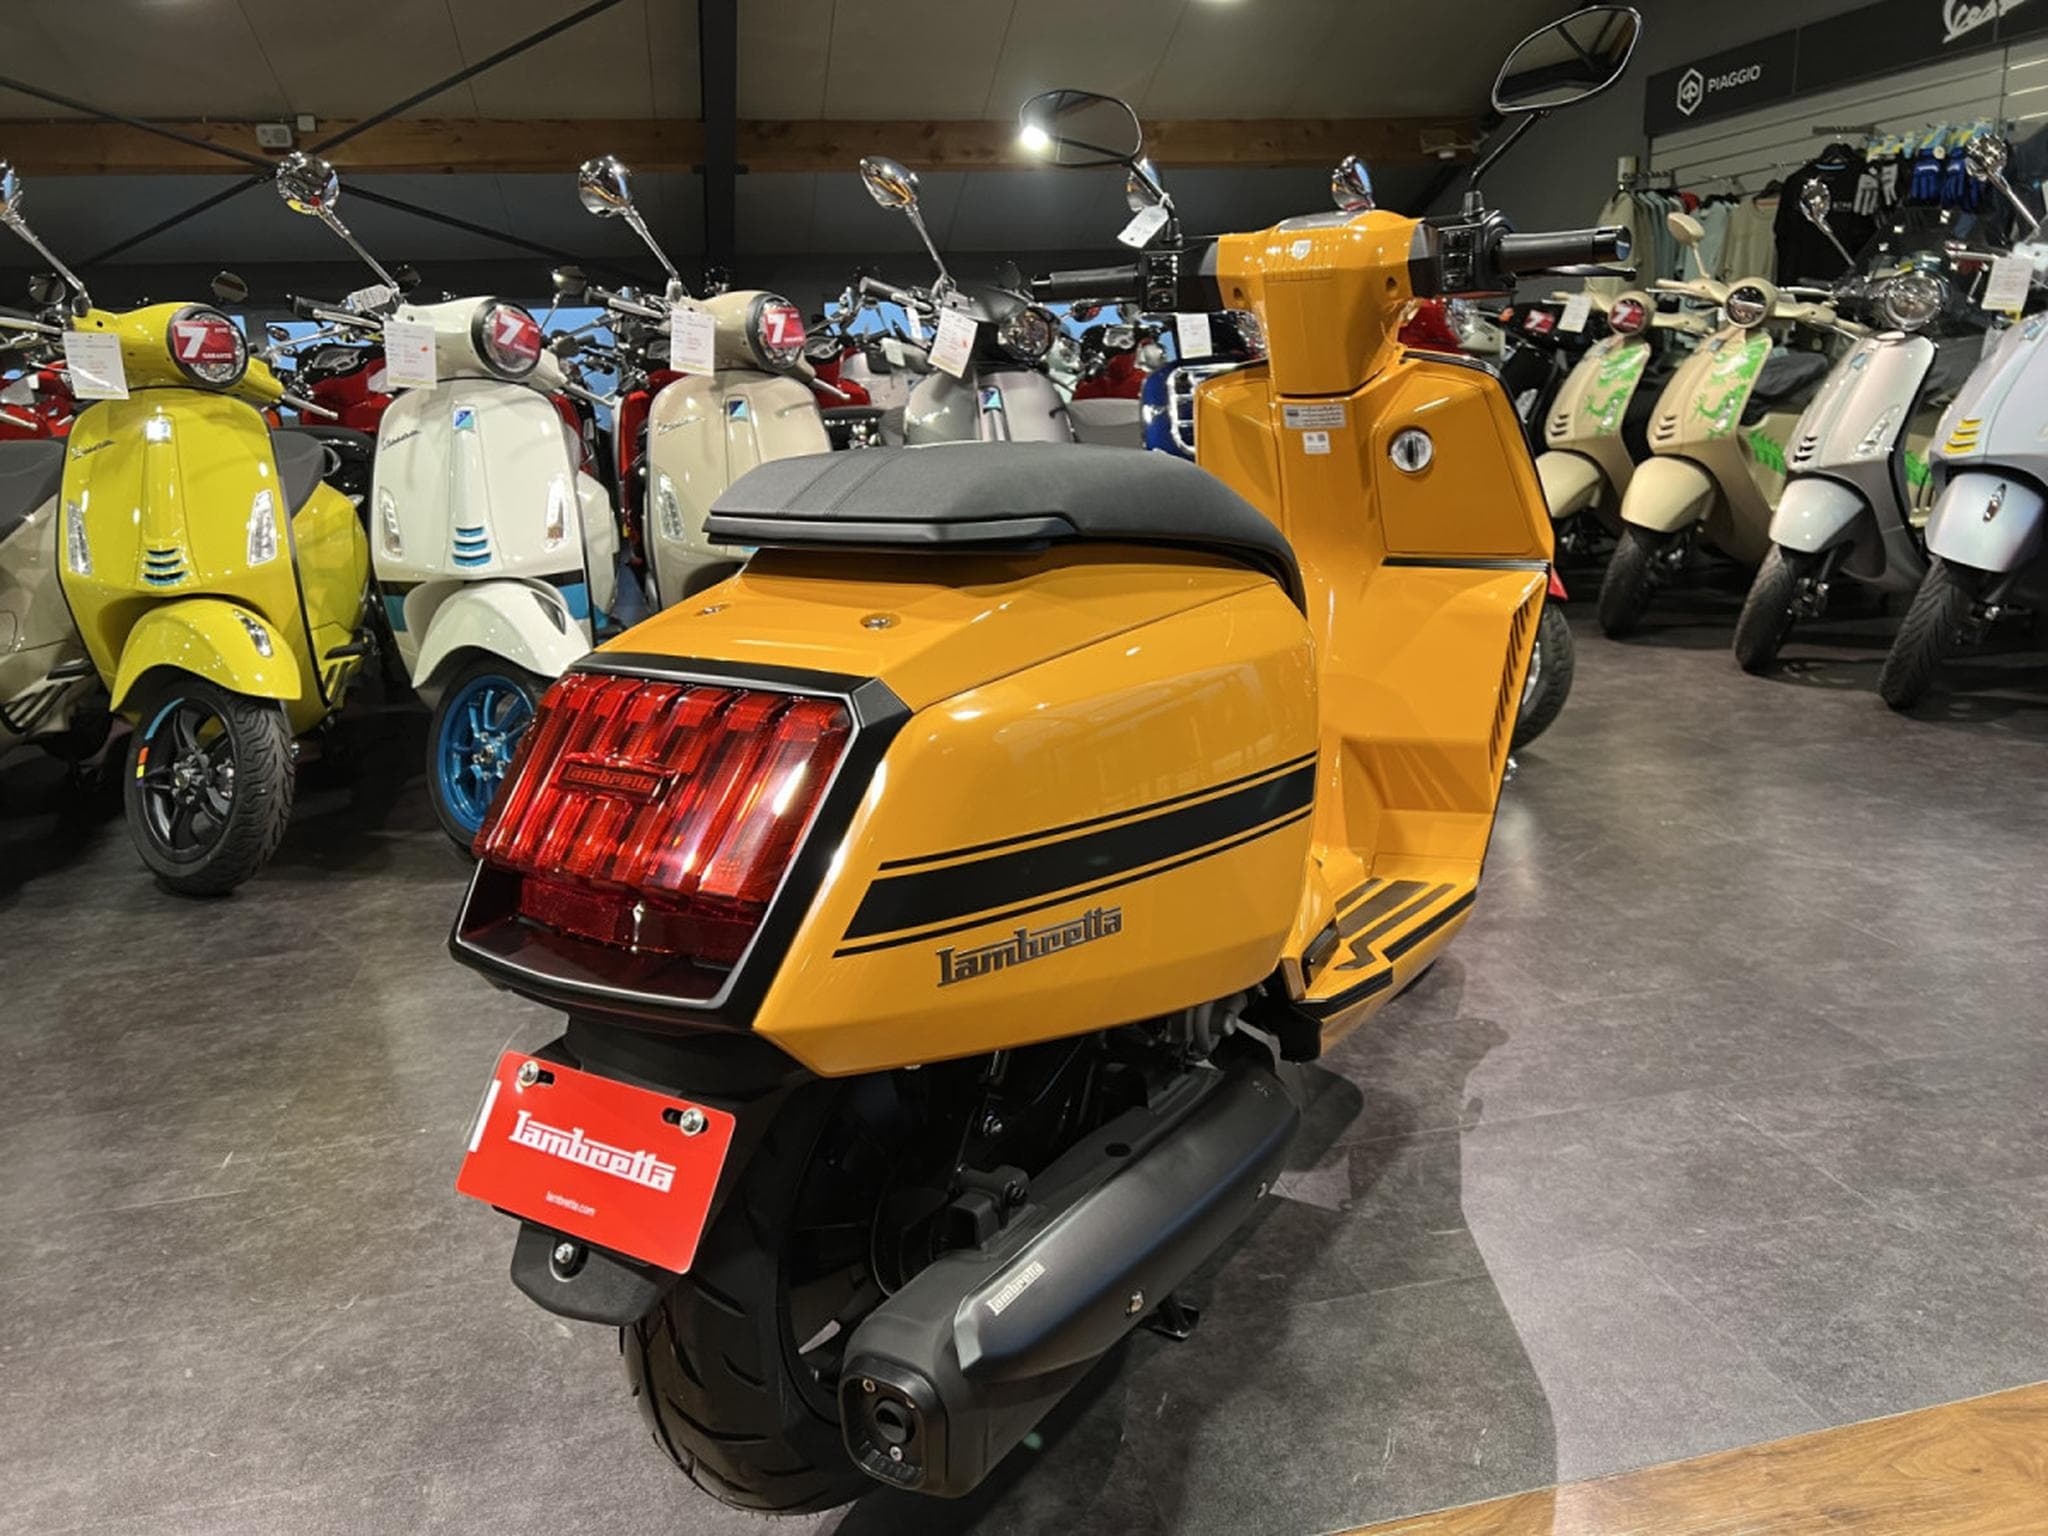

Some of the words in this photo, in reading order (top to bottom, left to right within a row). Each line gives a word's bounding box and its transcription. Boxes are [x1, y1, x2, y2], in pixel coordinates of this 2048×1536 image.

[1707, 65, 1760, 92] PIAGGIO
[177, 326, 208, 358] 7
[498, 314, 525, 345] 7
[767, 313, 787, 344] 7
[936, 906, 1122, 988] Lambretta
[508, 1109, 677, 1193] Lambretta
[545, 1190, 596, 1216] lambretta.com
